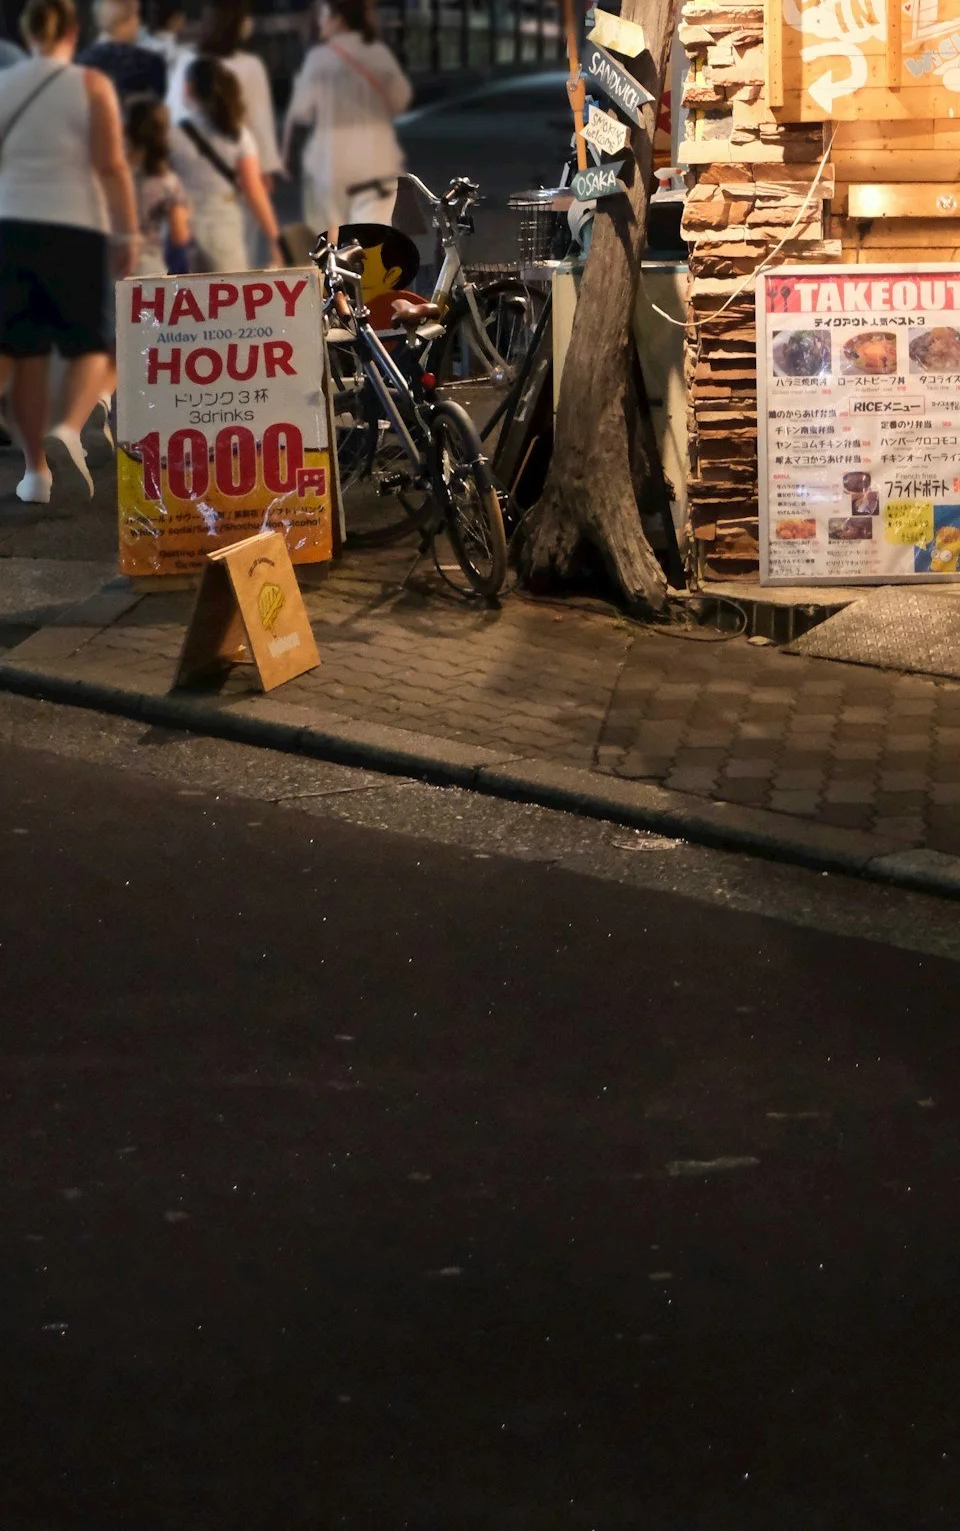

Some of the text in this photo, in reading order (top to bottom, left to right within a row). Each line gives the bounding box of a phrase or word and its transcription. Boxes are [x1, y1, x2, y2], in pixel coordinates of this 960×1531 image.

[588, 51, 640, 113] SANDWICH
[577, 169, 617, 196] OSAKA
[131, 279, 309, 326] HAPPY
[814, 316, 926, 328] テイクアウト人気ベスト3
[157, 326, 273, 344] Allday 11:00-22:00
[147, 340, 298, 386] HOUR
[853, 401, 921, 412] RICEメニュー
[189, 409, 255, 424] 3drinks
[775, 439, 861, 450] ヤンニョムチキン弁当
[880, 436, 958, 447] ハンバーグロコモコ
[131, 422, 326, 501] 1000円
[884, 478, 950, 498] フライドポテト
